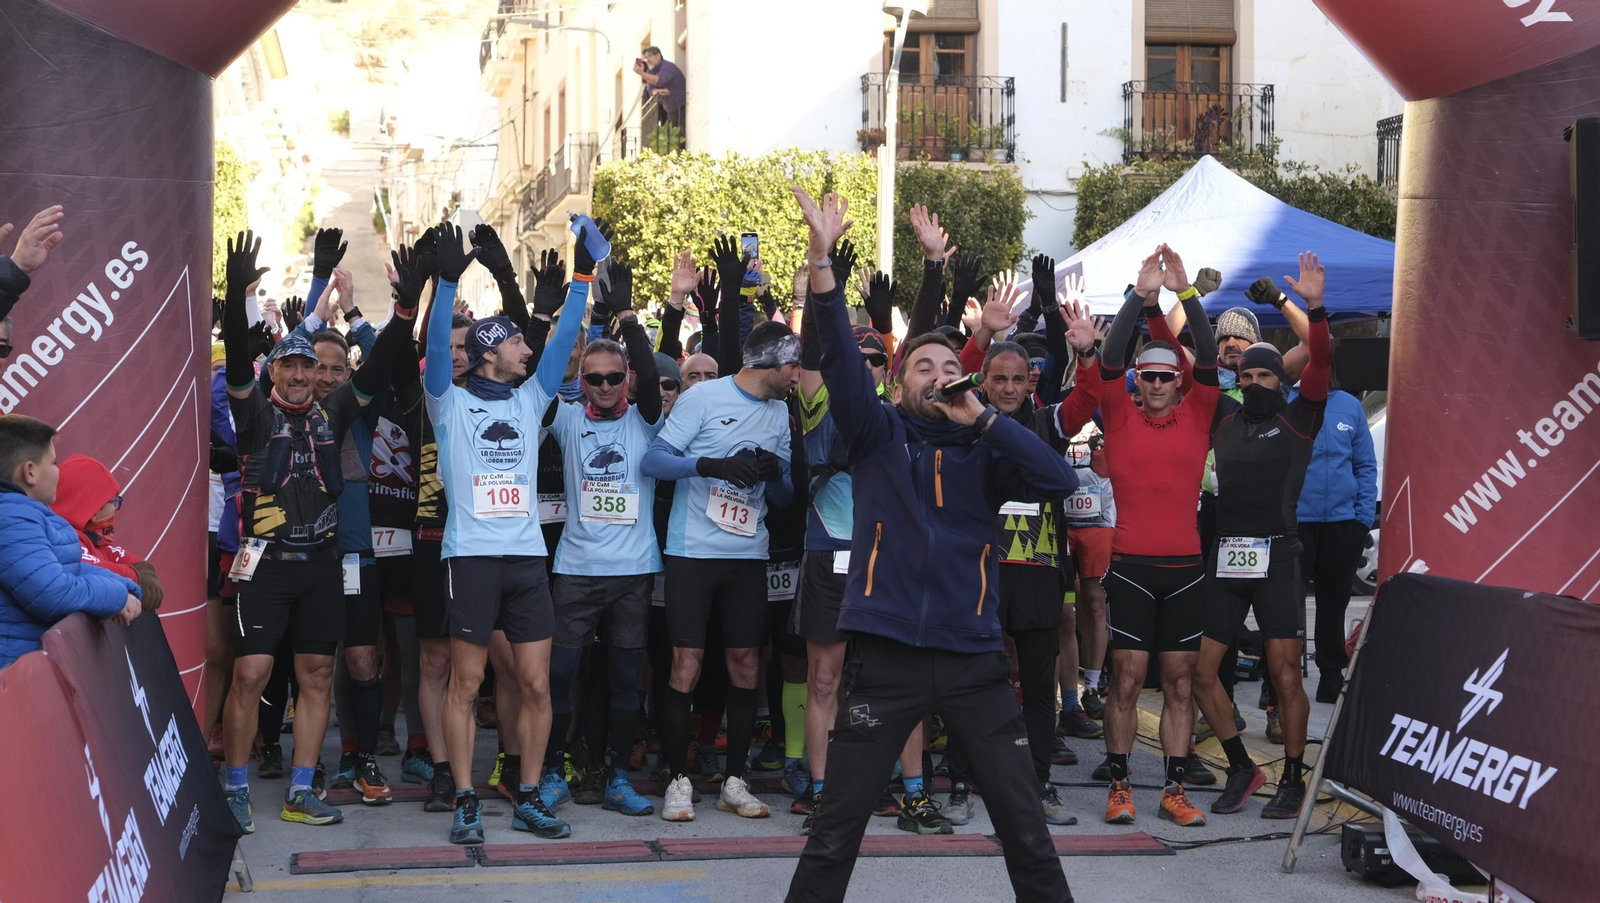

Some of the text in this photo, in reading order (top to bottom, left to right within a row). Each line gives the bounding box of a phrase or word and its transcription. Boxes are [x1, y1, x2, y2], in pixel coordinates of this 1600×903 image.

[1443, 361, 1600, 534] www.team
[486, 487, 520, 506] 108
[592, 495, 627, 513] 358
[1068, 496, 1092, 510] 109
[720, 501, 749, 525] 113
[1227, 550, 1258, 567] 238
[767, 573, 792, 590] 08
[144, 712, 189, 827] TEAMERGY
[1379, 713, 1558, 810] TEAMERGY
[1393, 791, 1484, 843] www.teamergy.es
